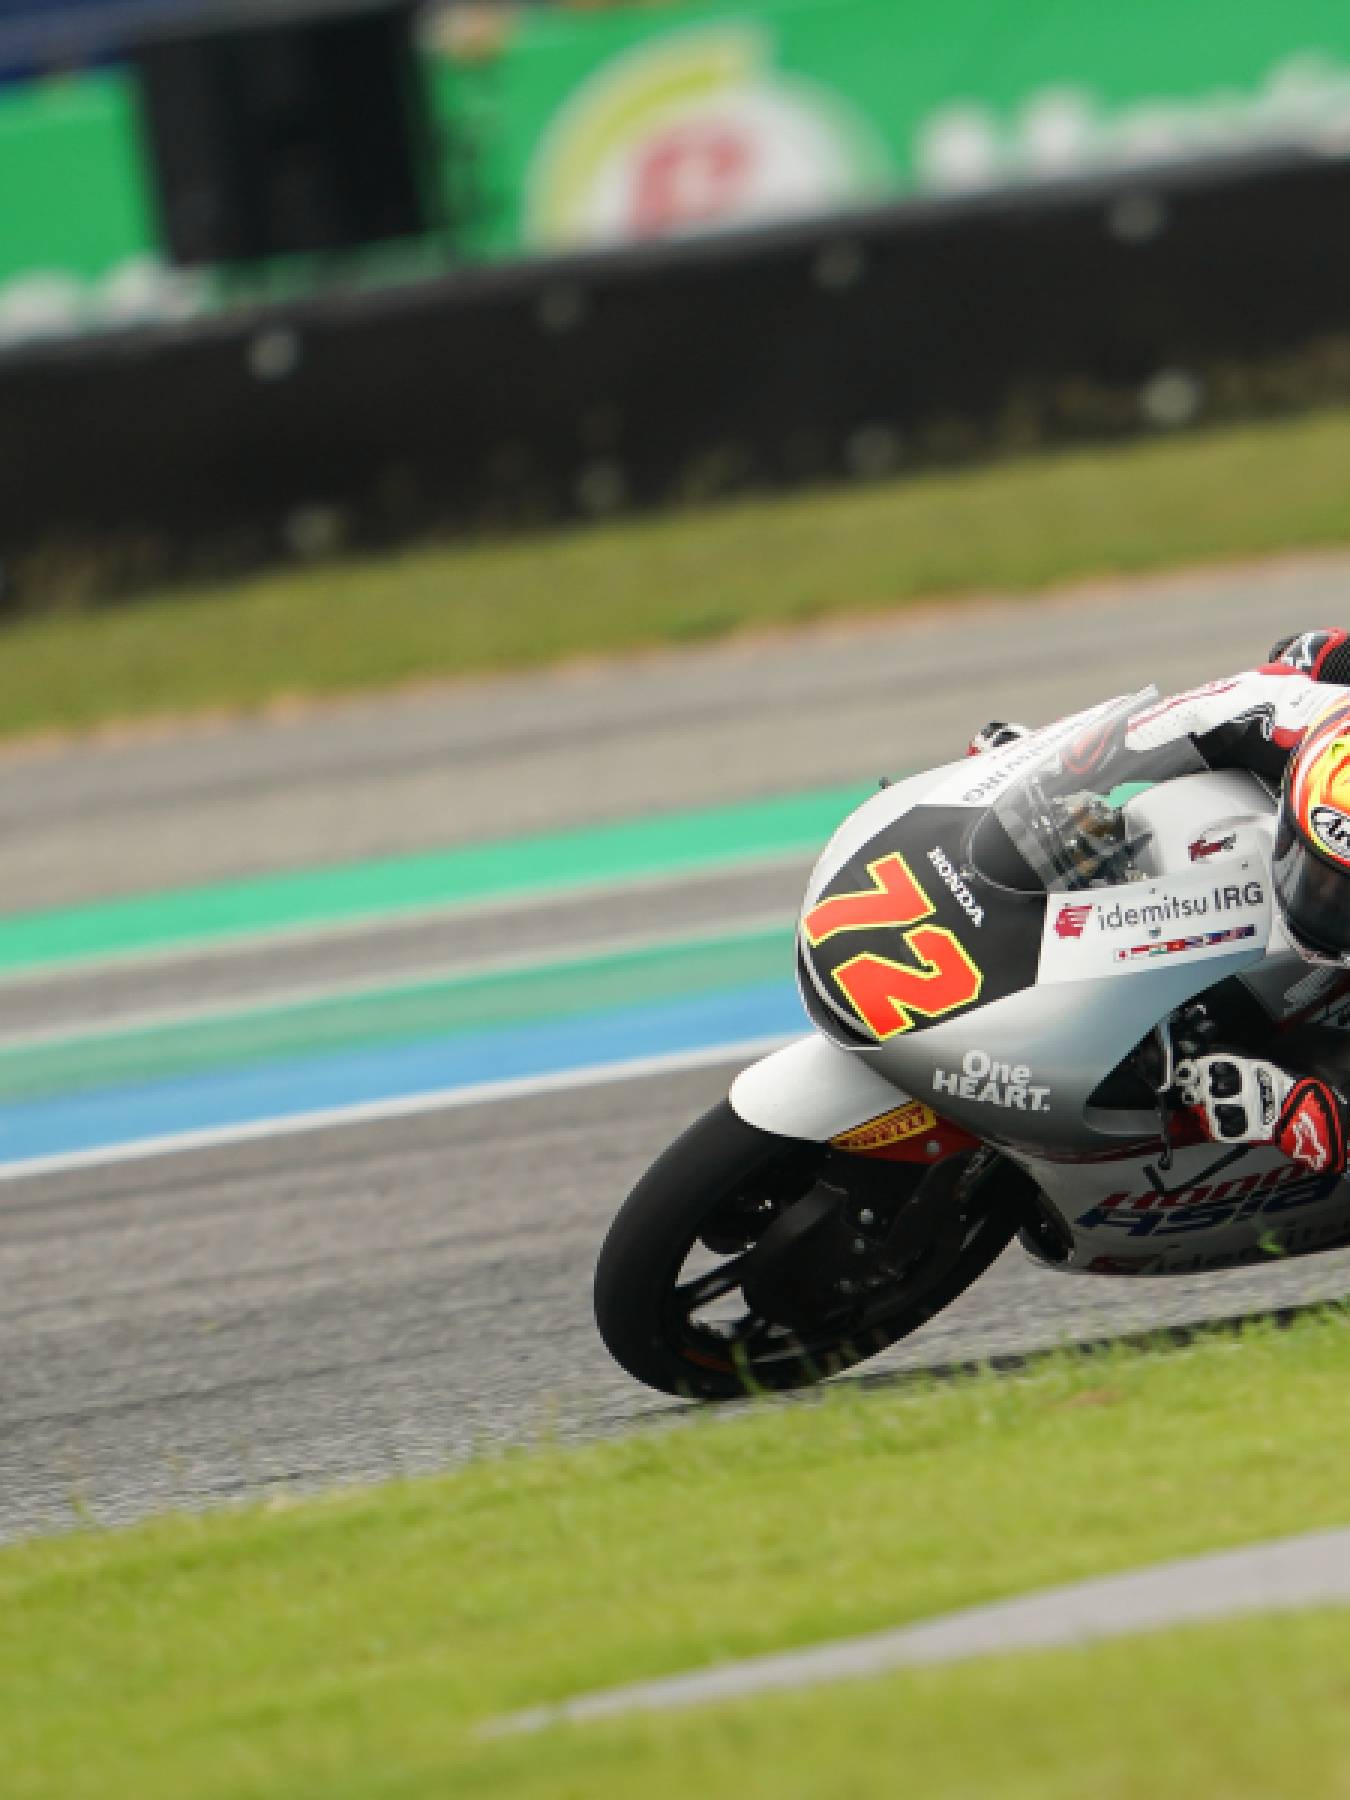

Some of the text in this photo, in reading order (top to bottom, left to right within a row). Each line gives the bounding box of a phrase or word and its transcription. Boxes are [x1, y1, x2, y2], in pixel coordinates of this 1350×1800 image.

[927, 846, 985, 928] HONDA
[1097, 881, 1264, 931] idemitsu IRG
[801, 851, 985, 1041] 72
[962, 1050, 1032, 1084] One
